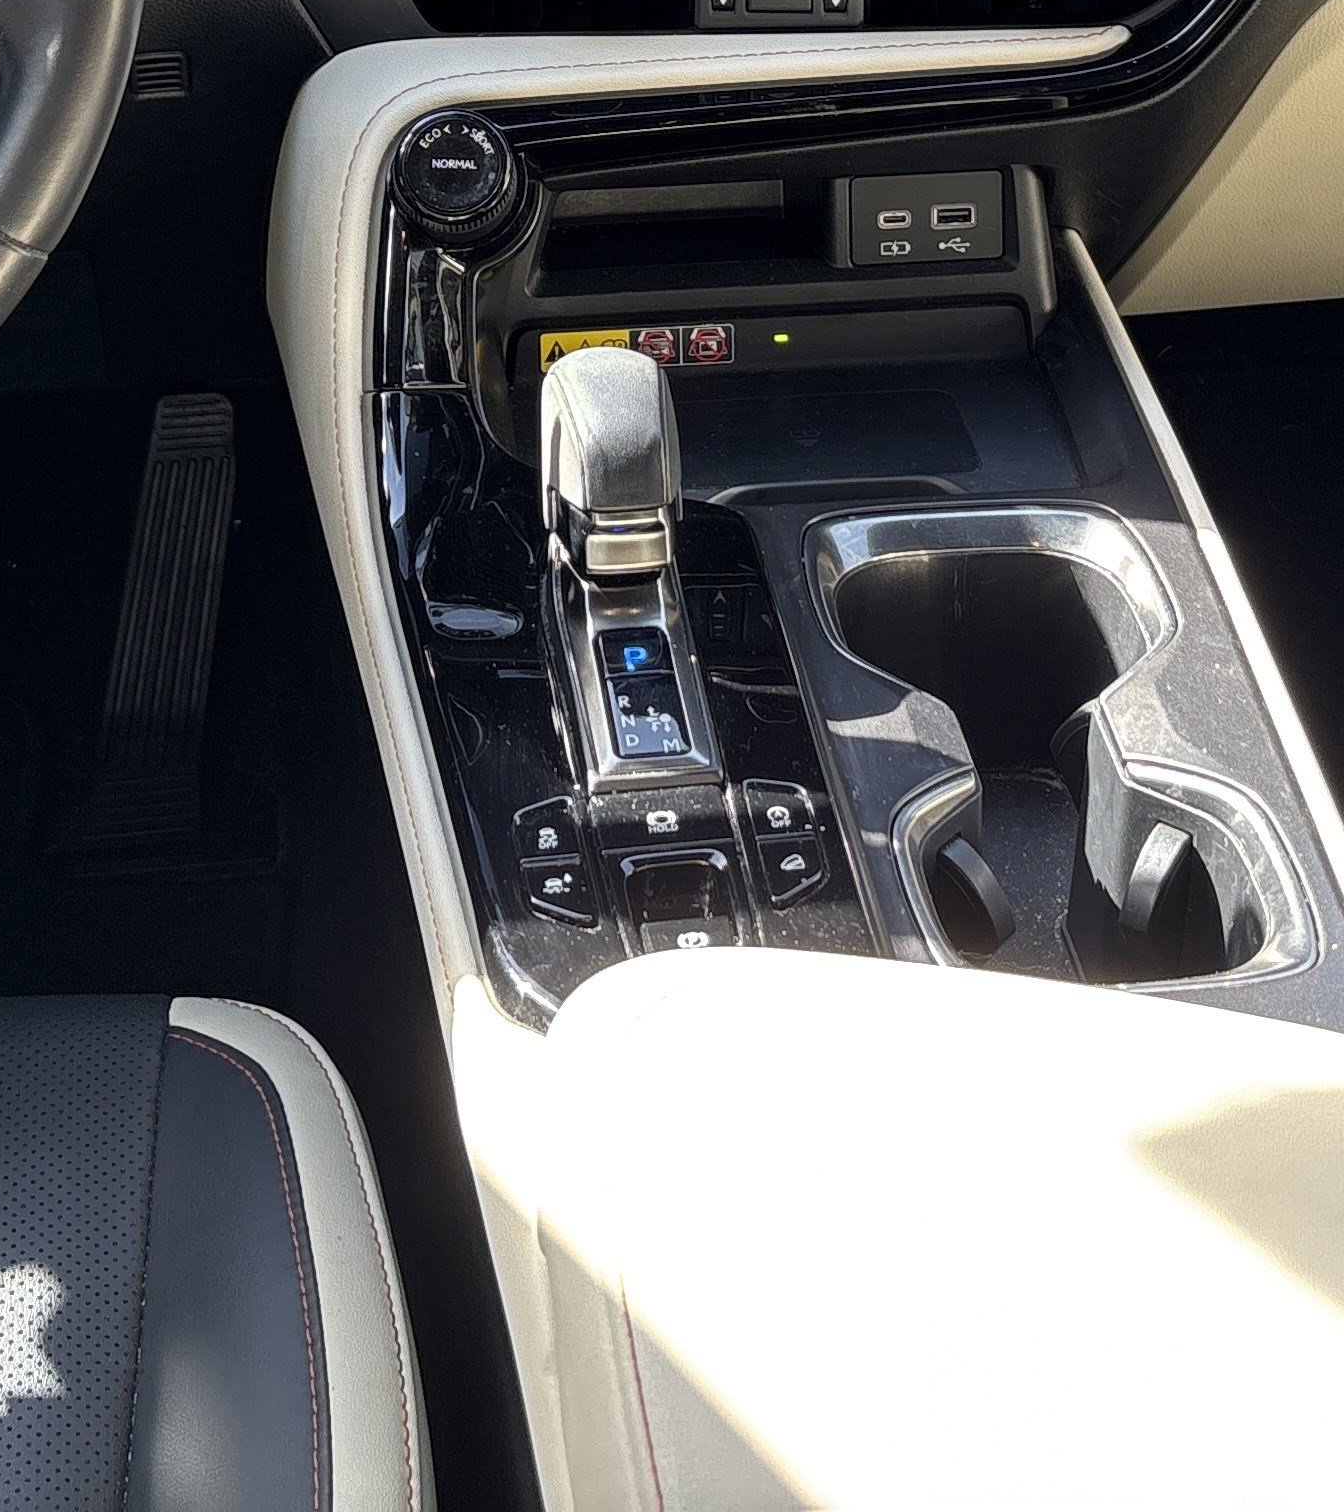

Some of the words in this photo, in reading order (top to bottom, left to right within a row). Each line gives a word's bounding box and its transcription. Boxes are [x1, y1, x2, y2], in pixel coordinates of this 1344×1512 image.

[419, 128, 442, 149] ECO
[469, 127, 495, 155] SPORT
[431, 158, 478, 170] NORMAL
[623, 646, 647, 671] P
[617, 695, 631, 709] R
[620, 713, 636, 729] N
[625, 733, 640, 748] D
[662, 738, 682, 754] M
[647, 822, 679, 835] HOLD
[770, 819, 792, 829] OFF
[537, 839, 558, 850] OFF
